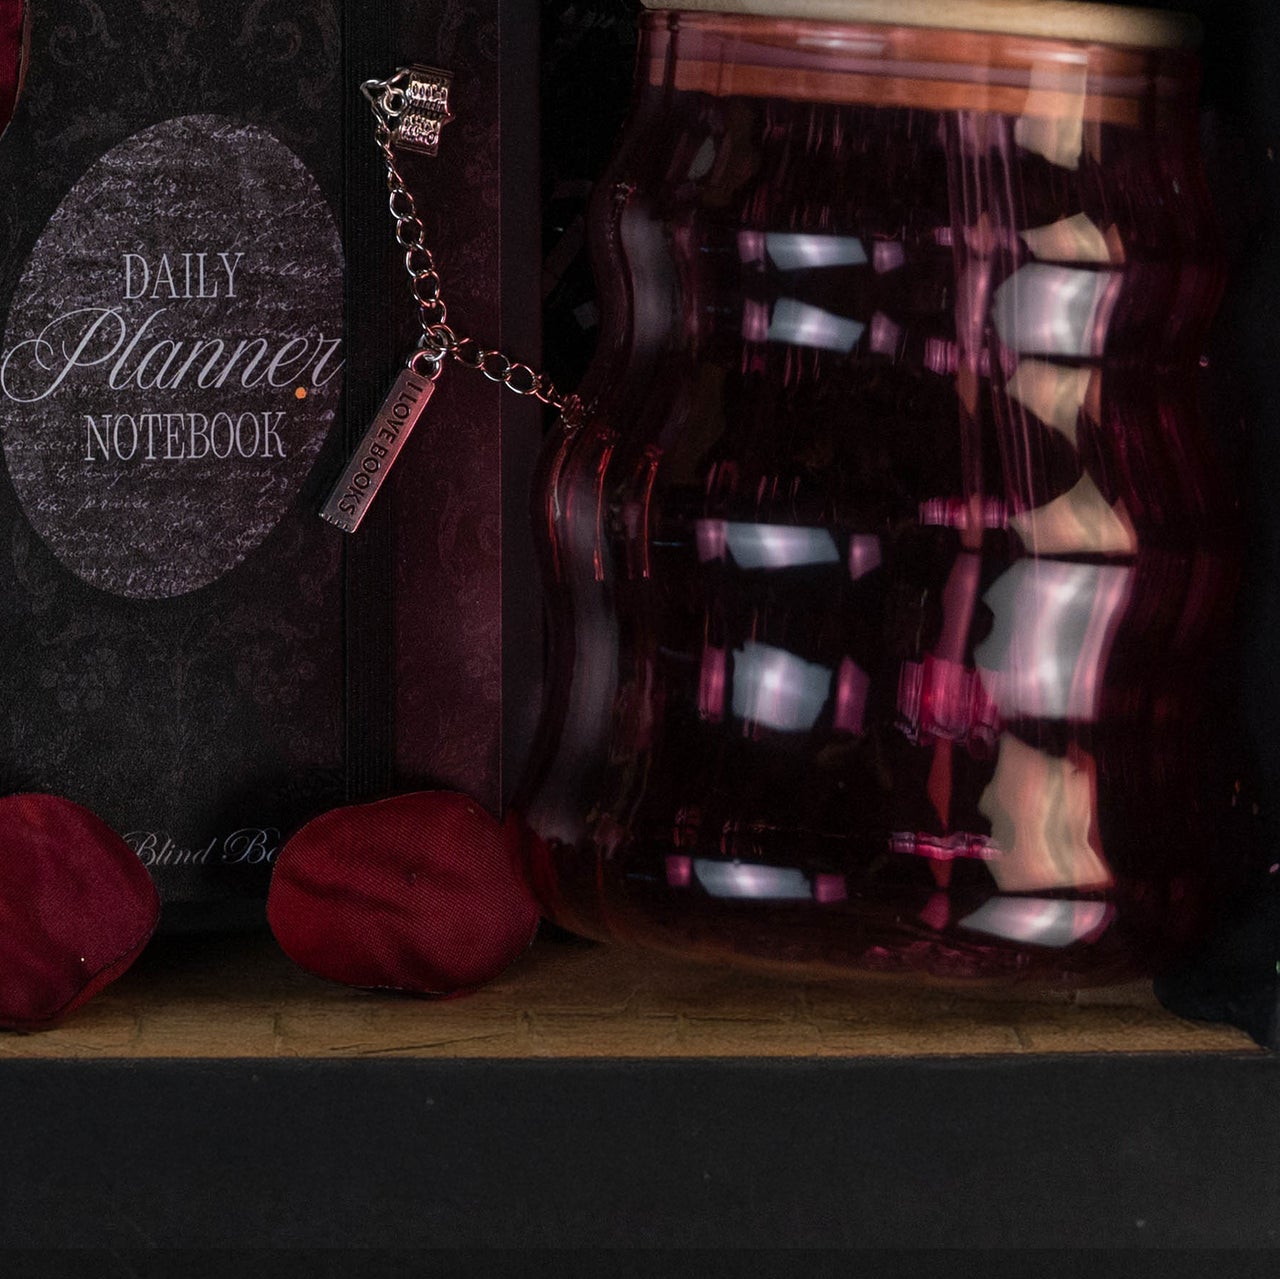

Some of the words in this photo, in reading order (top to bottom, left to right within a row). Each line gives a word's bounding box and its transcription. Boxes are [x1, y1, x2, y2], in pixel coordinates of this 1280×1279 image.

[122, 252, 245, 300] DAILY
[0, 306, 346, 403] Planner
[406, 381, 423, 393] I
[83, 411, 286, 461] NOTEBOOK
[378, 392, 418, 444] LOVE
[340, 442, 388, 515] BOOKS
[122, 830, 217, 866] Blind
